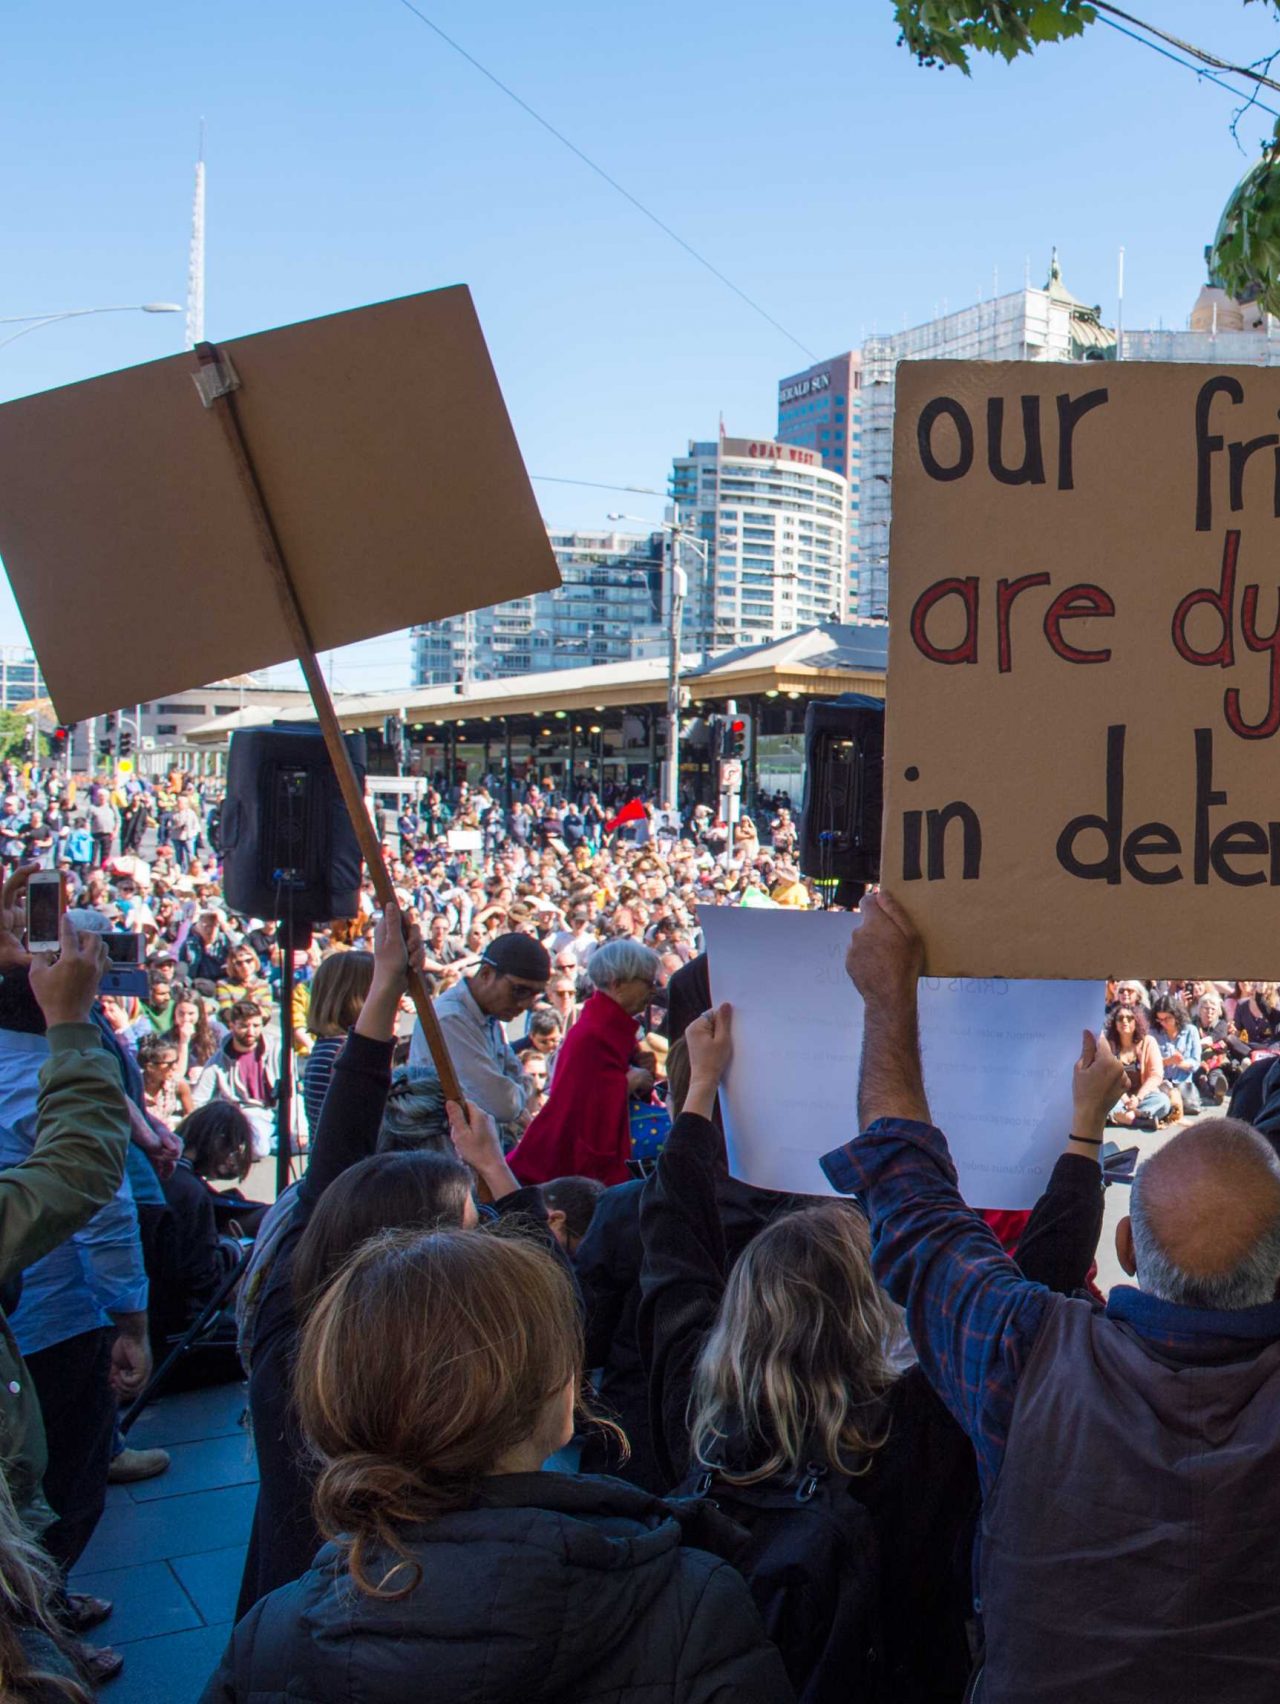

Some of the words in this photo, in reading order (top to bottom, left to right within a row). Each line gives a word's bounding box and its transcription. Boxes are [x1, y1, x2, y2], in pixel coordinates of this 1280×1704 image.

[749, 443, 783, 459] QUAY
[790, 449, 814, 464] WEST
[917, 387, 1109, 491] our
[910, 571, 1116, 674] are
[902, 765, 982, 881] in
